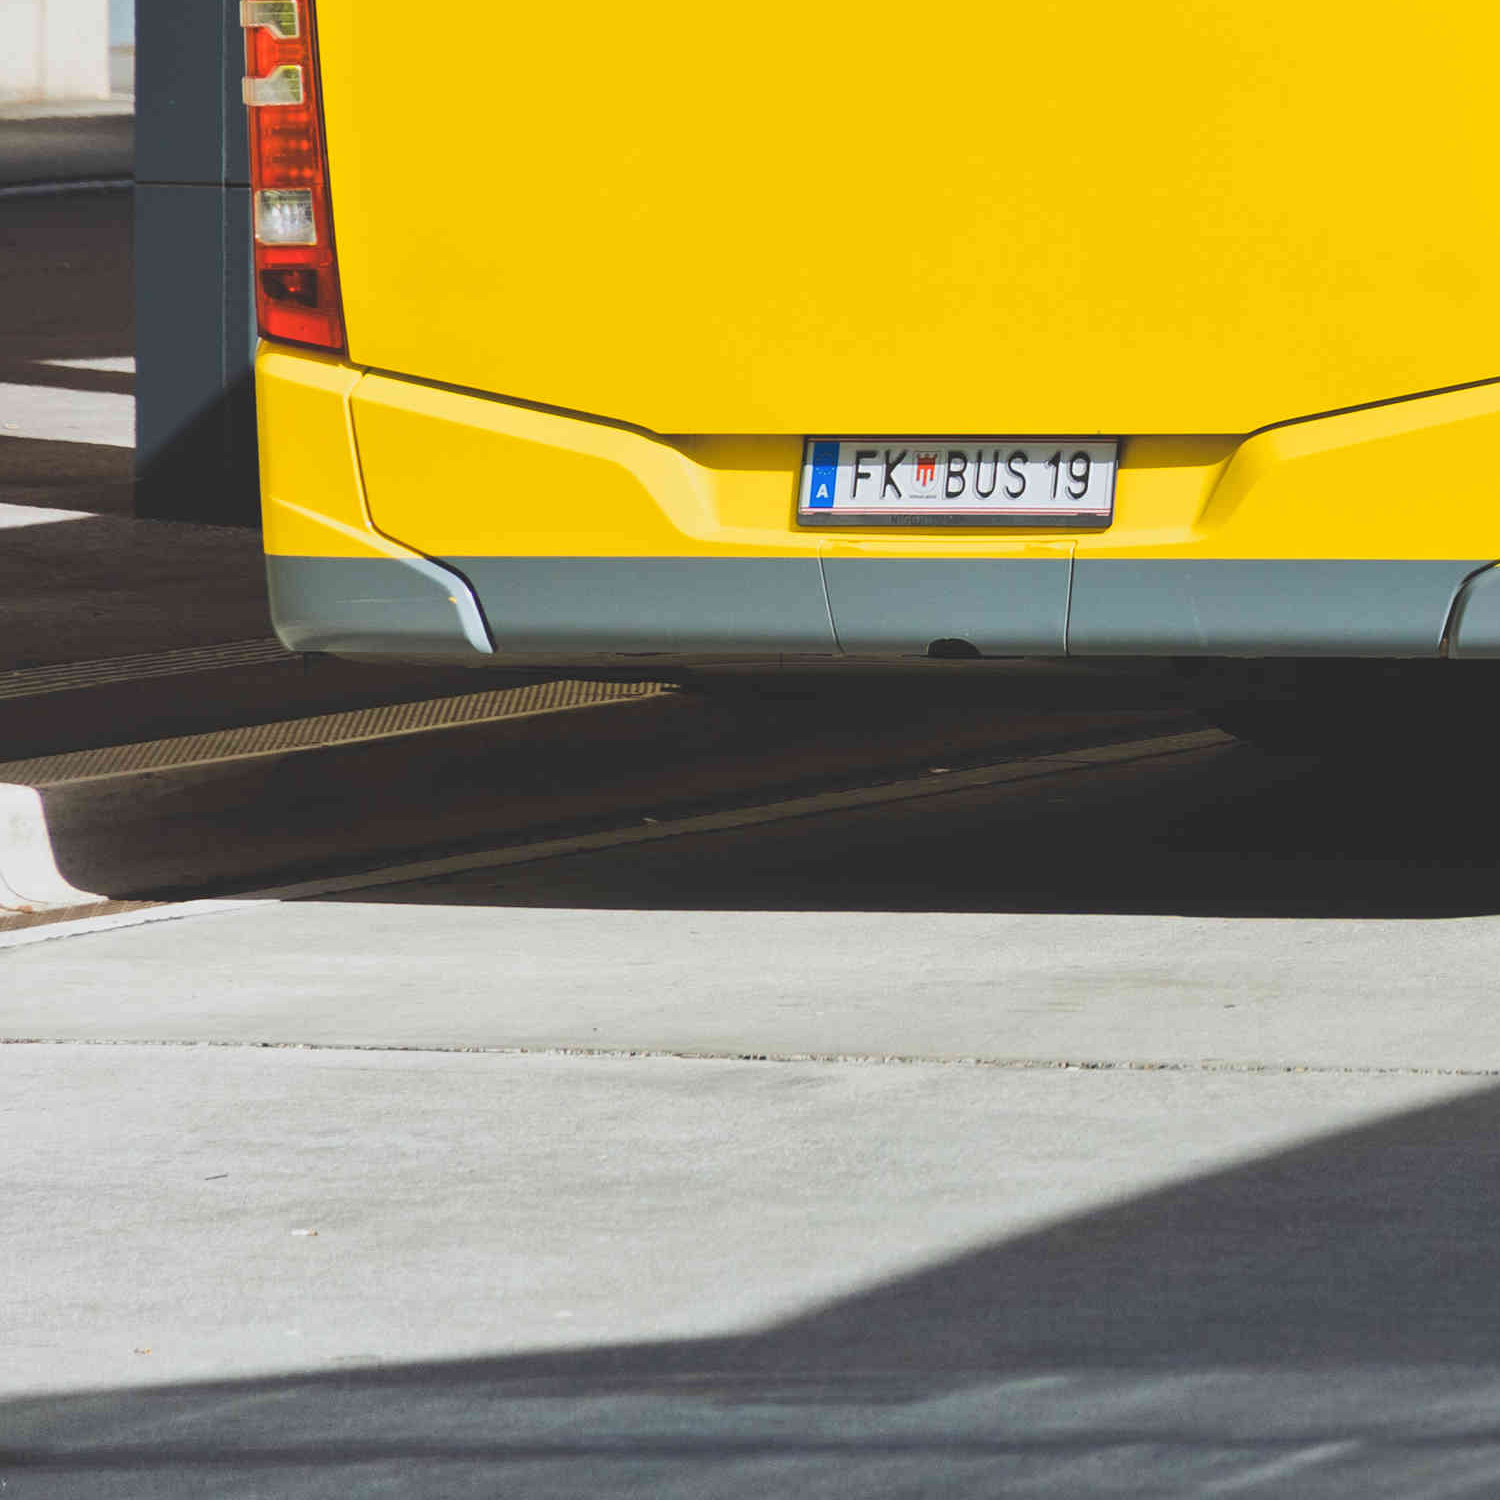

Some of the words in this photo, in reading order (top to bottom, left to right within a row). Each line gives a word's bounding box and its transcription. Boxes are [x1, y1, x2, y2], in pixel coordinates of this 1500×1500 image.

[816, 484, 829, 499] A
[852, 451, 907, 500] FK
[945, 451, 1029, 500] BUS
[1044, 451, 1091, 500] 19
